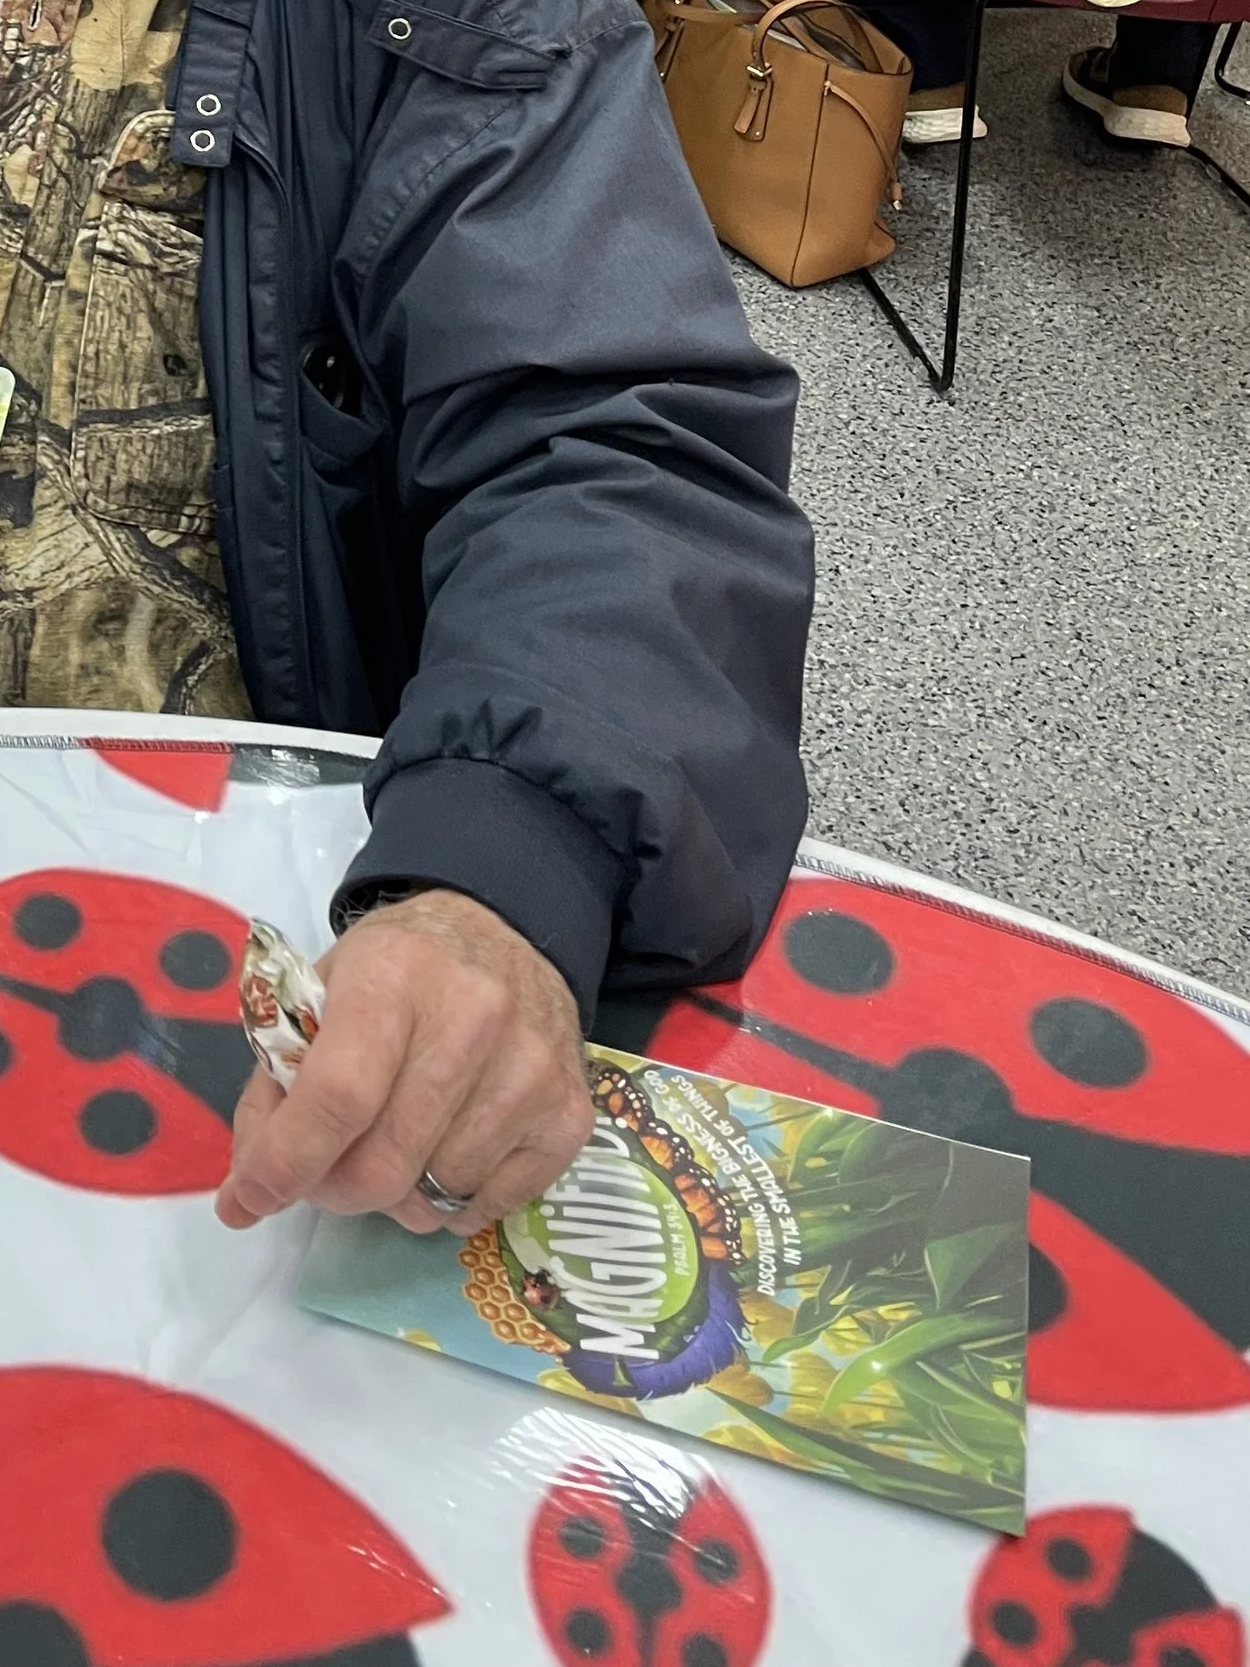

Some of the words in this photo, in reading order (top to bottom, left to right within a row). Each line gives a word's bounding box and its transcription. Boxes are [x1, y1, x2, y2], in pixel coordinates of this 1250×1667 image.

[644, 1069, 670, 1095] GOD
[662, 1095, 682, 1113] OF
[670, 1074, 719, 1122] THINGS
[714, 1119, 735, 1137] OF
[677, 1113, 742, 1175] BIGNESS
[728, 1136, 791, 1215] SMALLEST
[732, 1173, 759, 1202] THE
[779, 1216, 800, 1246] THE
[672, 1233, 690, 1277] PSALM
[748, 1201, 777, 1297] DISCOVERING
[783, 1245, 802, 1266] IN
